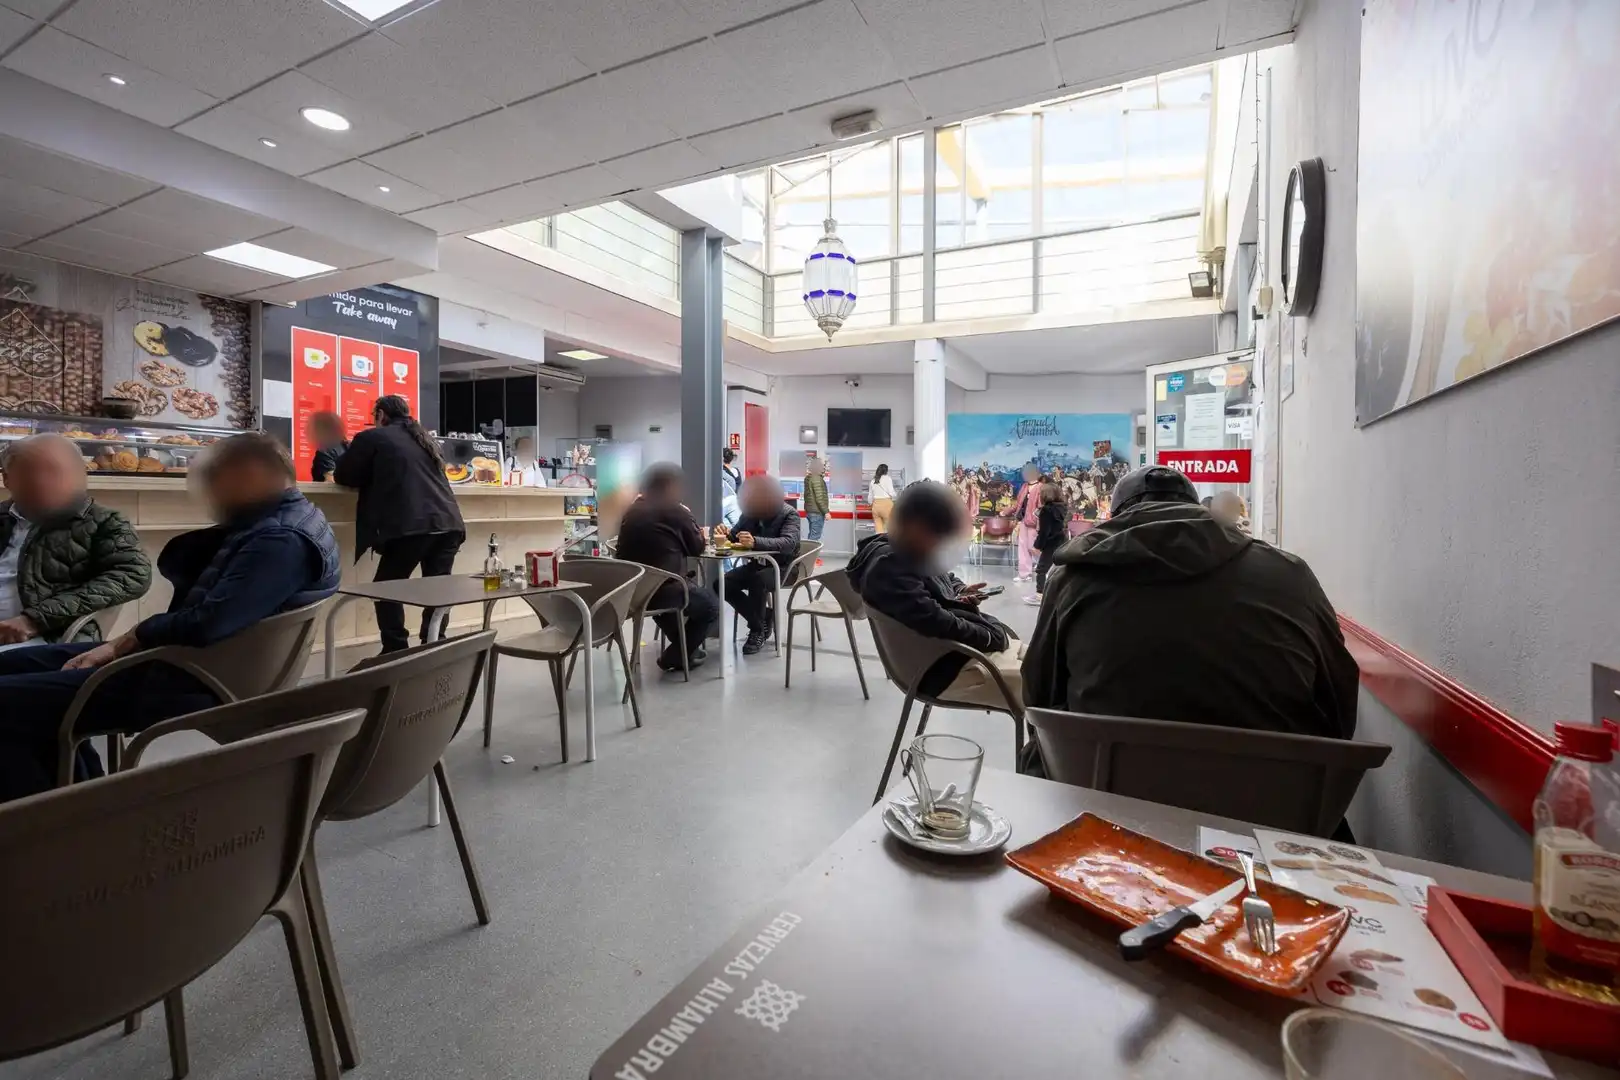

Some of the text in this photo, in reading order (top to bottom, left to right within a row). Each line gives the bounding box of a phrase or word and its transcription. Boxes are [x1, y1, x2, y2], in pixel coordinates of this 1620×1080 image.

[332, 301, 398, 330] Take away
[359, 298, 385, 311] para
[386, 302, 413, 316] llevar
[1167, 460, 1240, 473] ENTRADA
[594, 910, 803, 1080] CERVEZAS ALHAMBRA
